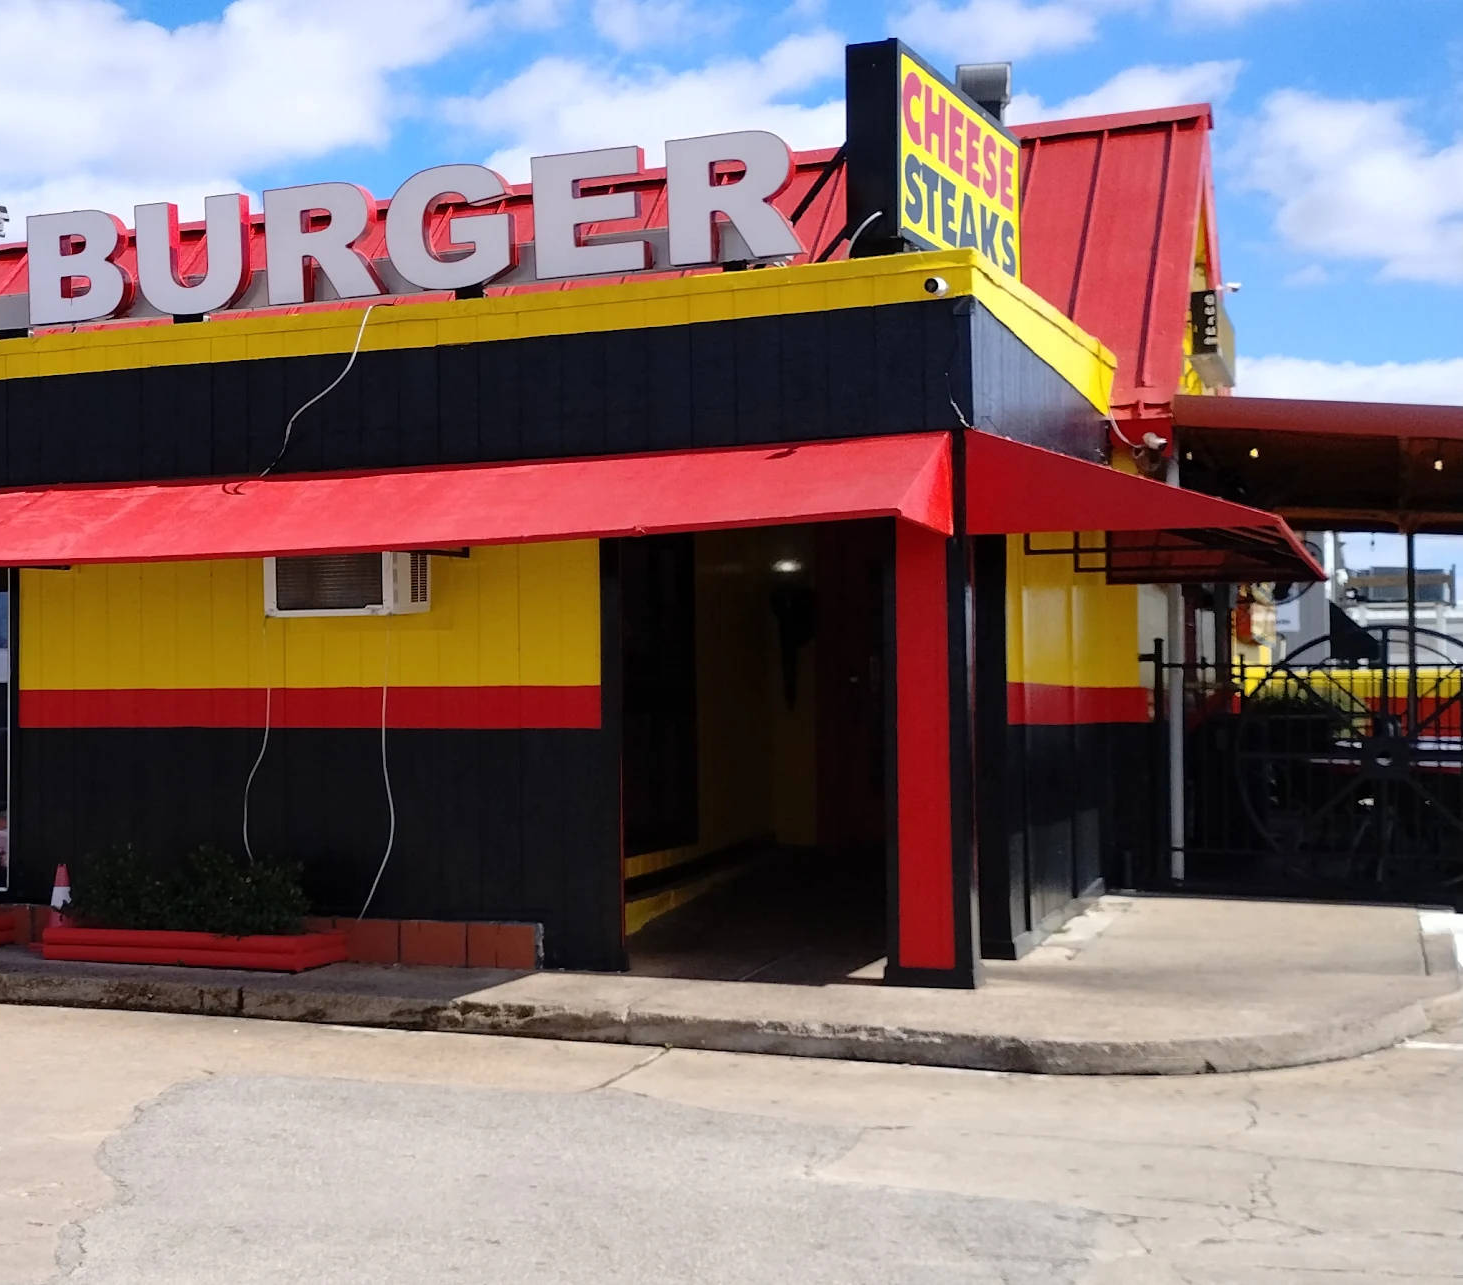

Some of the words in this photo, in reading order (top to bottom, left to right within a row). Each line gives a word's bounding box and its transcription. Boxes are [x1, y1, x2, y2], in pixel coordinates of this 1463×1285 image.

[902, 71, 1014, 212] CHEESE
[26, 130, 803, 326] BURGER
[904, 152, 1017, 278] STEAKS
